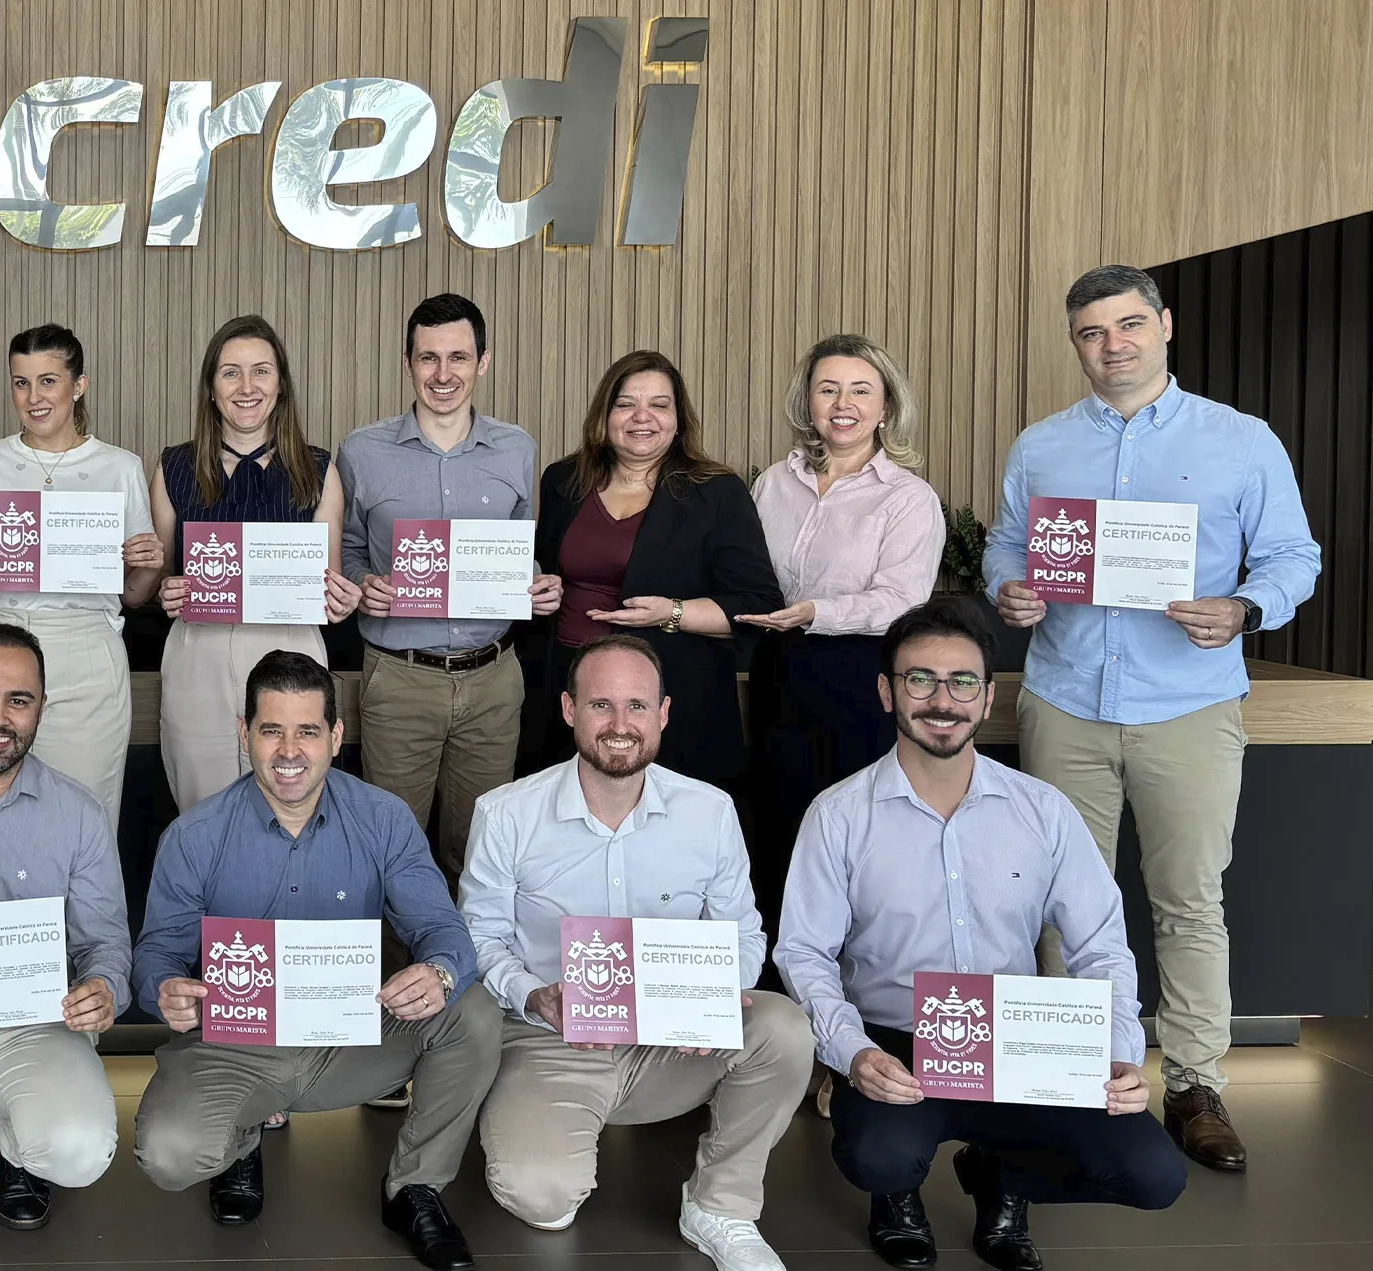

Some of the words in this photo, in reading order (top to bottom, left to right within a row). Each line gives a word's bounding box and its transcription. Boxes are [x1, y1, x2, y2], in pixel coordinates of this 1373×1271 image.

[46, 518, 119, 528] CERTIFICADO
[1102, 528, 1191, 542] CERTIFICADO
[248, 549, 323, 559] CERTIFICADO
[455, 545, 529, 555] CERTIFICADO
[1034, 569, 1086, 583] PUCPR
[191, 592, 236, 603] PUCPR
[398, 587, 442, 598] PUCPR
[282, 953, 374, 965] CERTIFICADO
[641, 951, 733, 965] CERTIFICADO
[211, 1005, 267, 1020] PUCPR
[571, 1004, 628, 1018] PUCPR
[1002, 1009, 1105, 1025] CERTIFICADO
[923, 1059, 984, 1075] PUCPR
